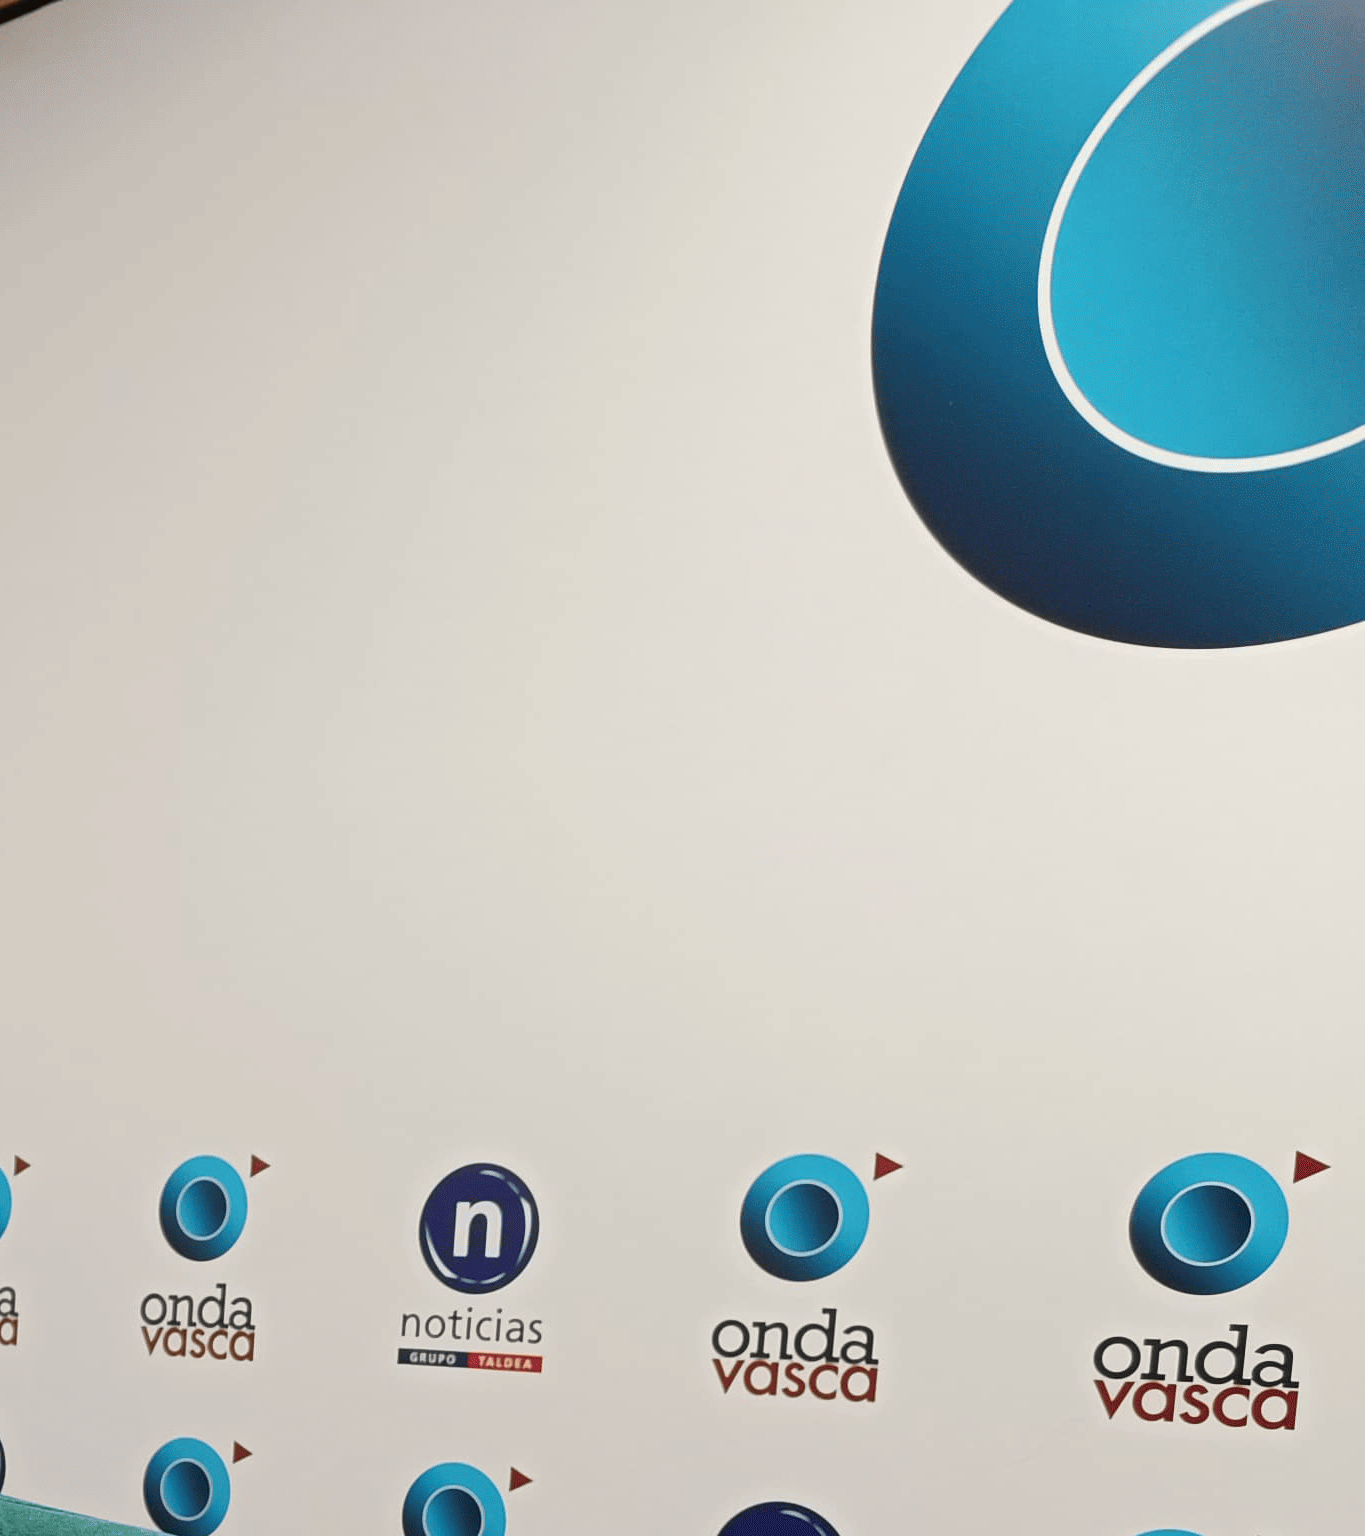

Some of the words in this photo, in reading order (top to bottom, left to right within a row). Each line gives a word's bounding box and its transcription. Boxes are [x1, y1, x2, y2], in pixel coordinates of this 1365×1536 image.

[140, 1284, 256, 1331] onda
[401, 1307, 543, 1345] noticias
[140, 1325, 256, 1362] vasca
[408, 1350, 457, 1365] GRUPO
[477, 1354, 533, 1370] TALDEA
[711, 1308, 879, 1366] onda
[1093, 1324, 1300, 1389] onda
[712, 1358, 879, 1403] vasca
[1093, 1379, 1300, 1431] vasca
